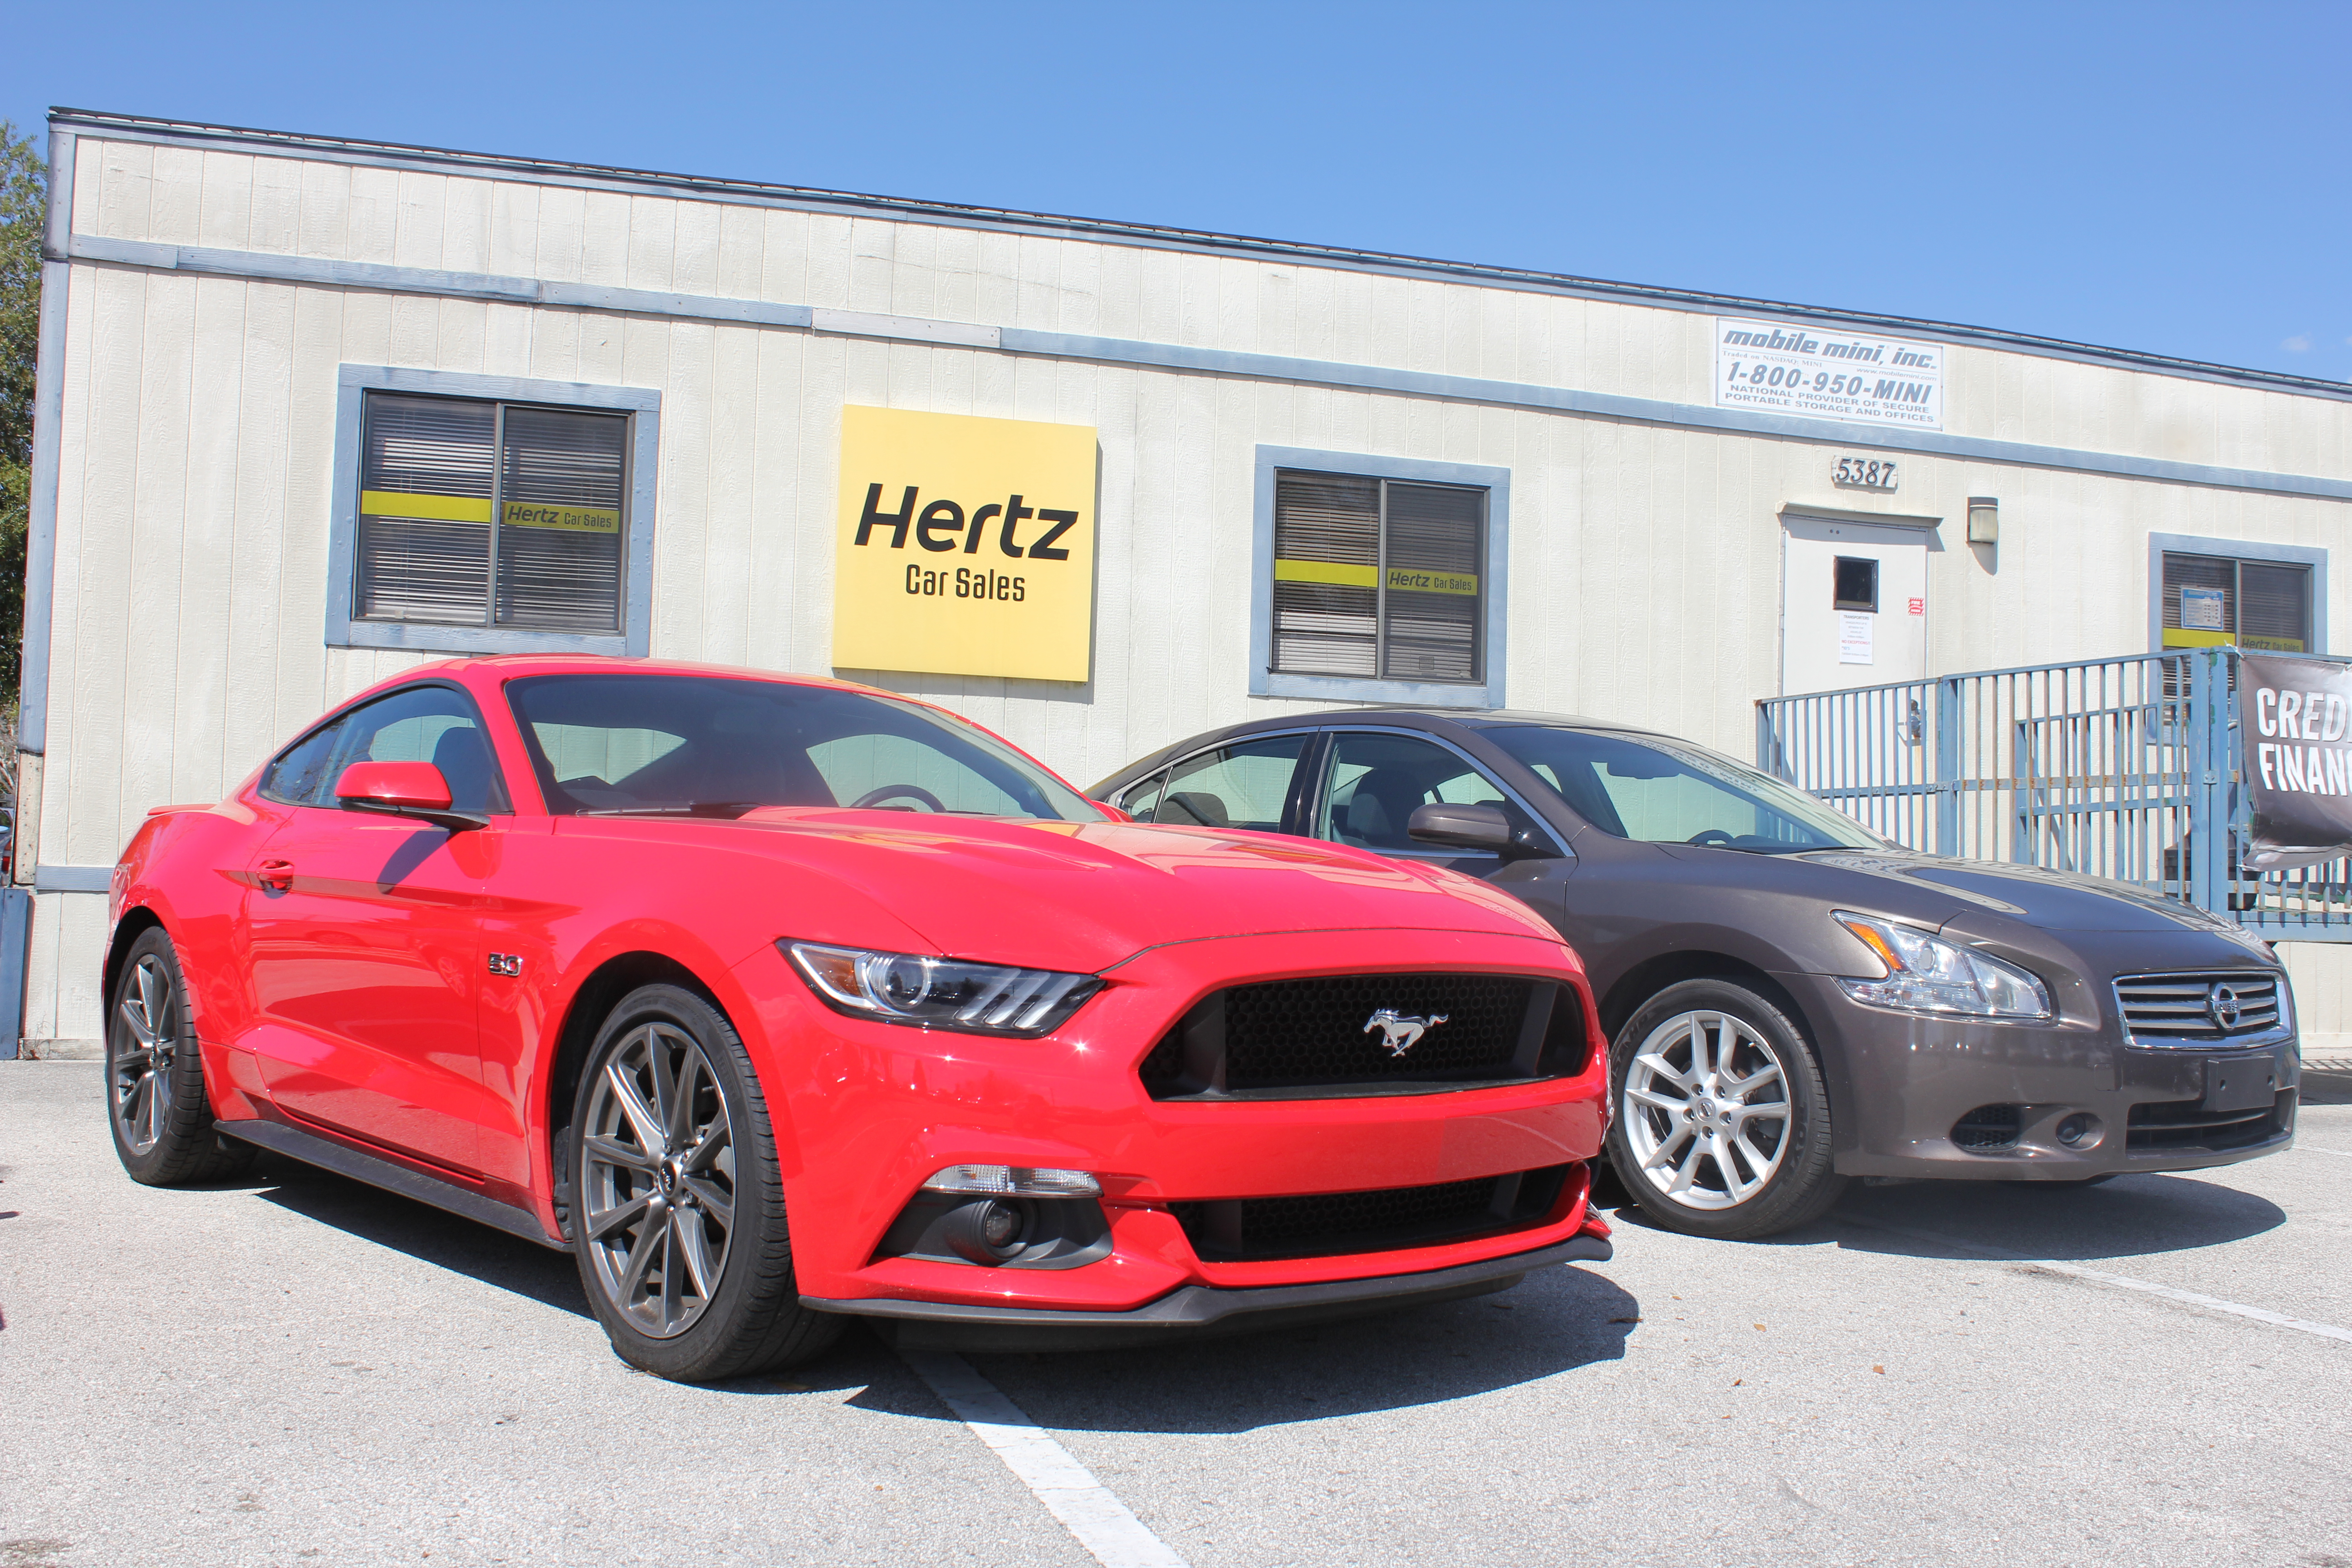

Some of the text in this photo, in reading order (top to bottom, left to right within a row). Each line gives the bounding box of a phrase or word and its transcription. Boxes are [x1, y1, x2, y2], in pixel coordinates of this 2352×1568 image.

[1723, 329, 1937, 369] mobile mini, inc.
[1727, 362, 1933, 404] 1-800-950-MINI
[1857, 368, 1937, 382] www.mobilemini.com
[1725, 392, 1934, 422] PORTABLE STORAGE AND OFFICES
[1730, 385, 1794, 397] NATIONAL
[1798, 392, 1859, 405] PROVIDER
[1882, 402, 1930, 413] SECURE
[1837, 458, 1896, 487] 5387
[508, 505, 612, 529] Hertz Car Sales
[854, 483, 1079, 561] Hertz
[906, 564, 1024, 602] Car Sales
[1389, 572, 1471, 591] Hertz Car Sales
[2242, 638, 2270, 649] Hertz
[2283, 643, 2299, 652] Sales
[2259, 743, 2352, 796] FINAN
